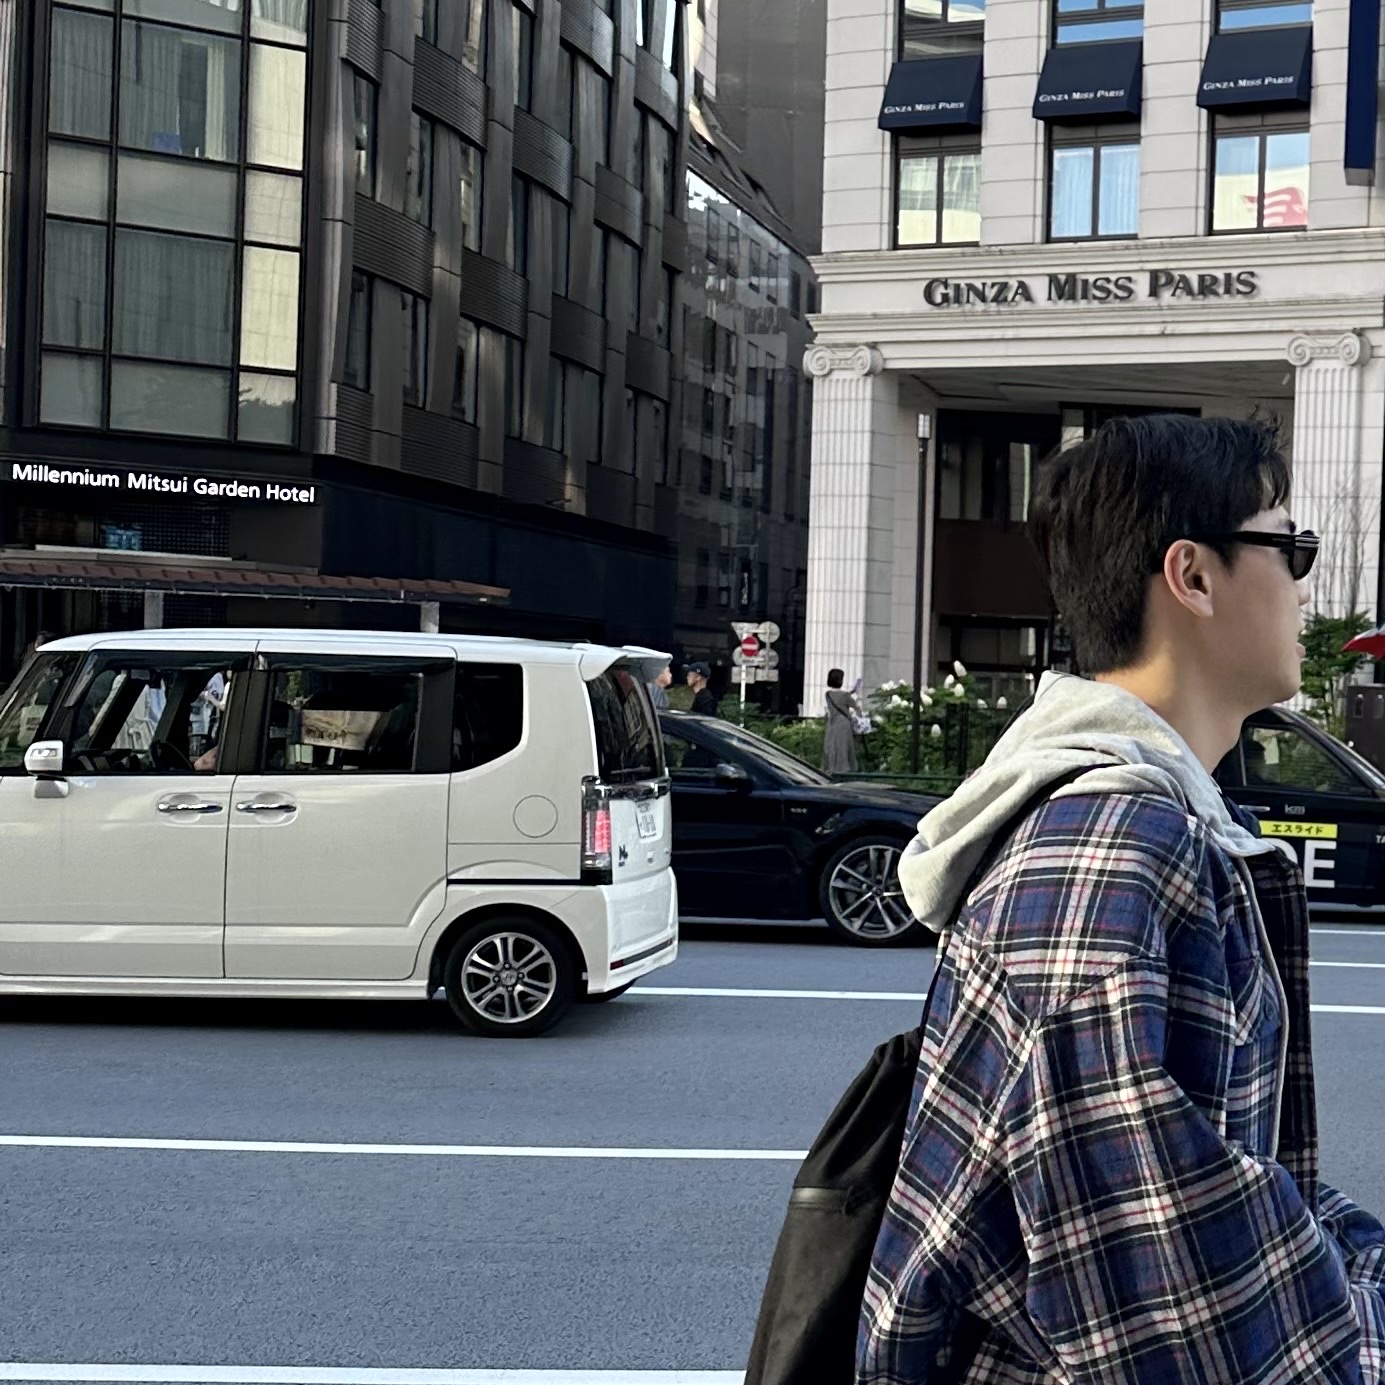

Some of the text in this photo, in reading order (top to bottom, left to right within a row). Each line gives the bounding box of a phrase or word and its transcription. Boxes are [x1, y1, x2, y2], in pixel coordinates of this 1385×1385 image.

[923, 268, 1257, 307] GINZA MISS PARIS
[12, 463, 315, 503] Millennium Mitsui Garden Hotel
[1271, 824, 1324, 835] エスライド
